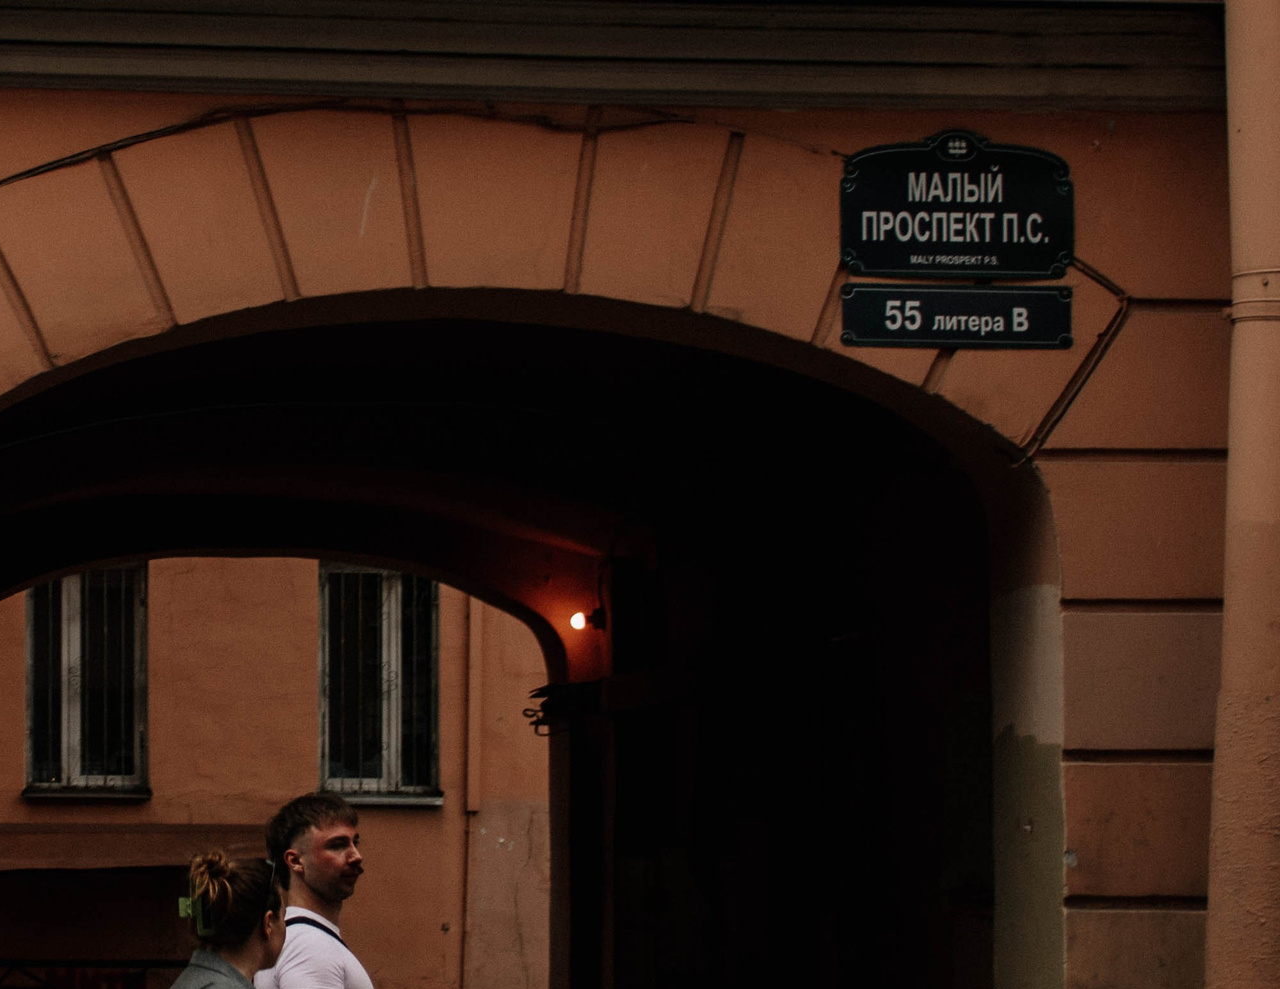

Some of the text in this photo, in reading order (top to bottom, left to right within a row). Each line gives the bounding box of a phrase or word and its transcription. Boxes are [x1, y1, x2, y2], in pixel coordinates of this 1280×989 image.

[907, 164, 1003, 204] МАЛЫЙ
[861, 211, 1050, 244] ПРОСПЕКТ П.С.
[910, 254, 1000, 266] MALY PROSPEKT P.S.
[884, 299, 1030, 336] 55 литера В
